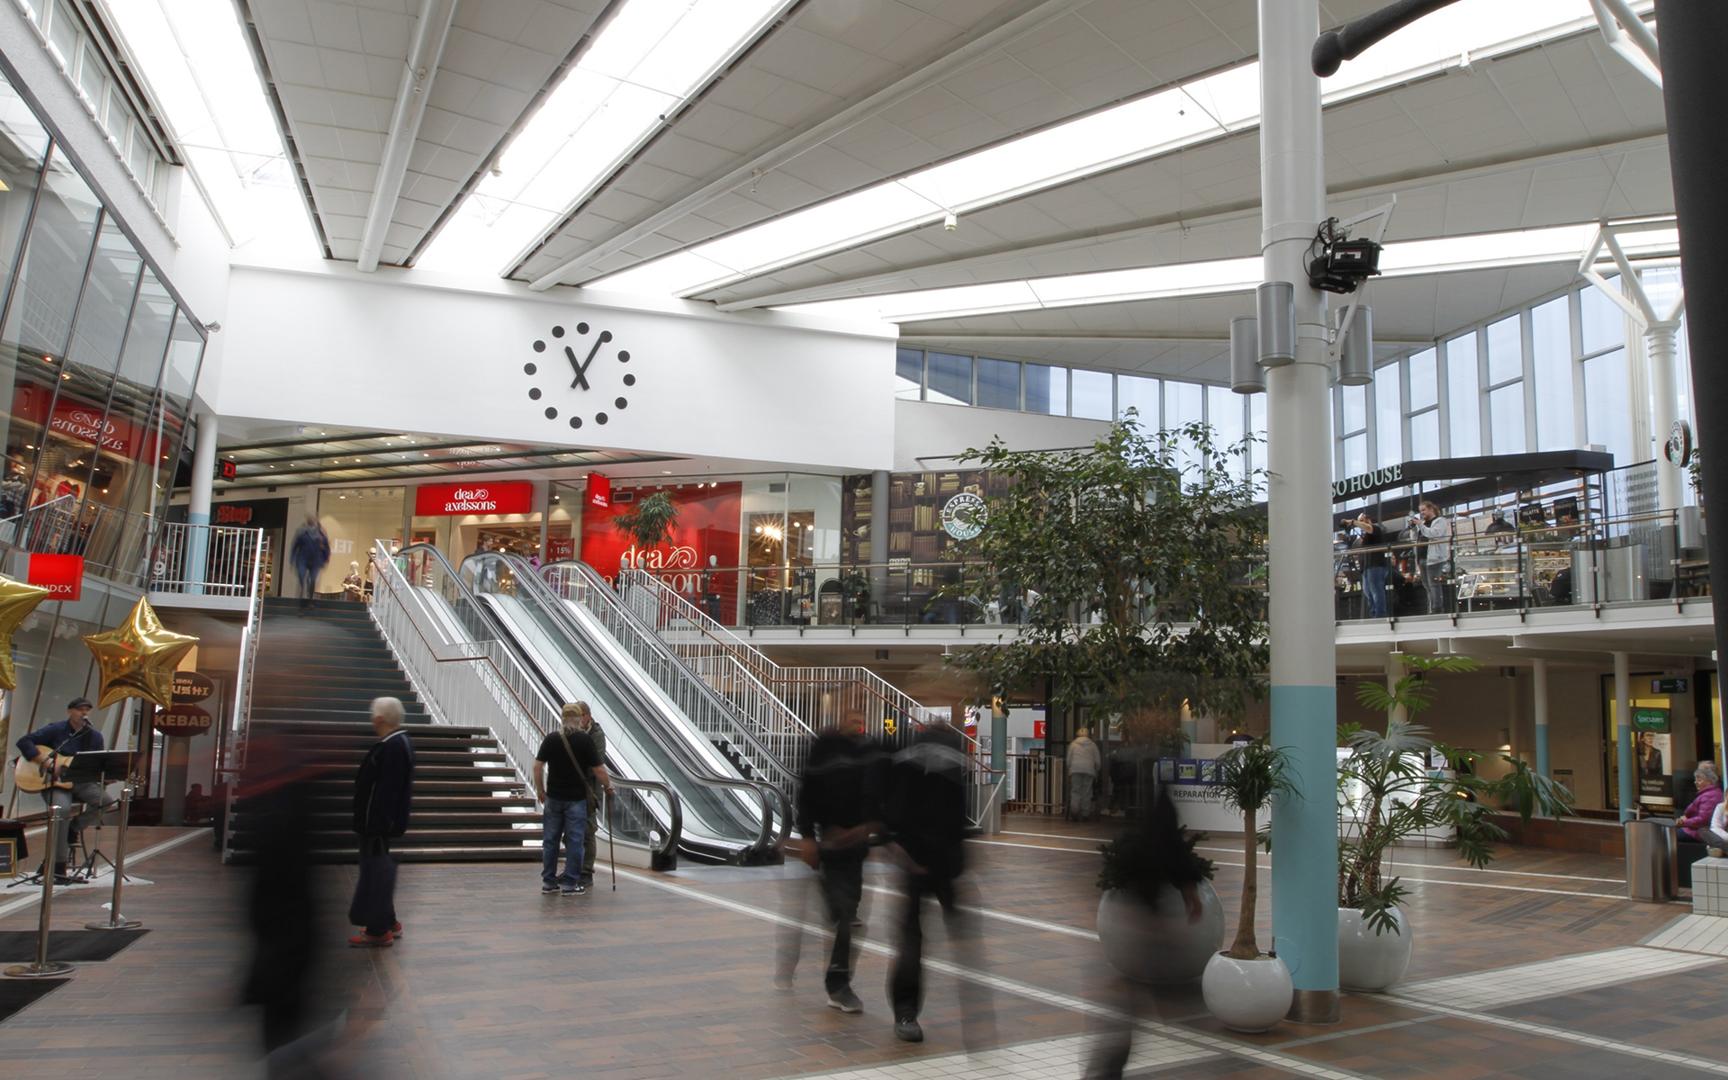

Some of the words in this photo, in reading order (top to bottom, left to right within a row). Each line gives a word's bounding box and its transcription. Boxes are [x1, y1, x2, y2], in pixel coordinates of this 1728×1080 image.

[1350, 464, 1403, 493] HOUSE
[454, 488, 474, 500] dea
[445, 499, 497, 512] axelssons
[154, 714, 210, 727] KEBAB
